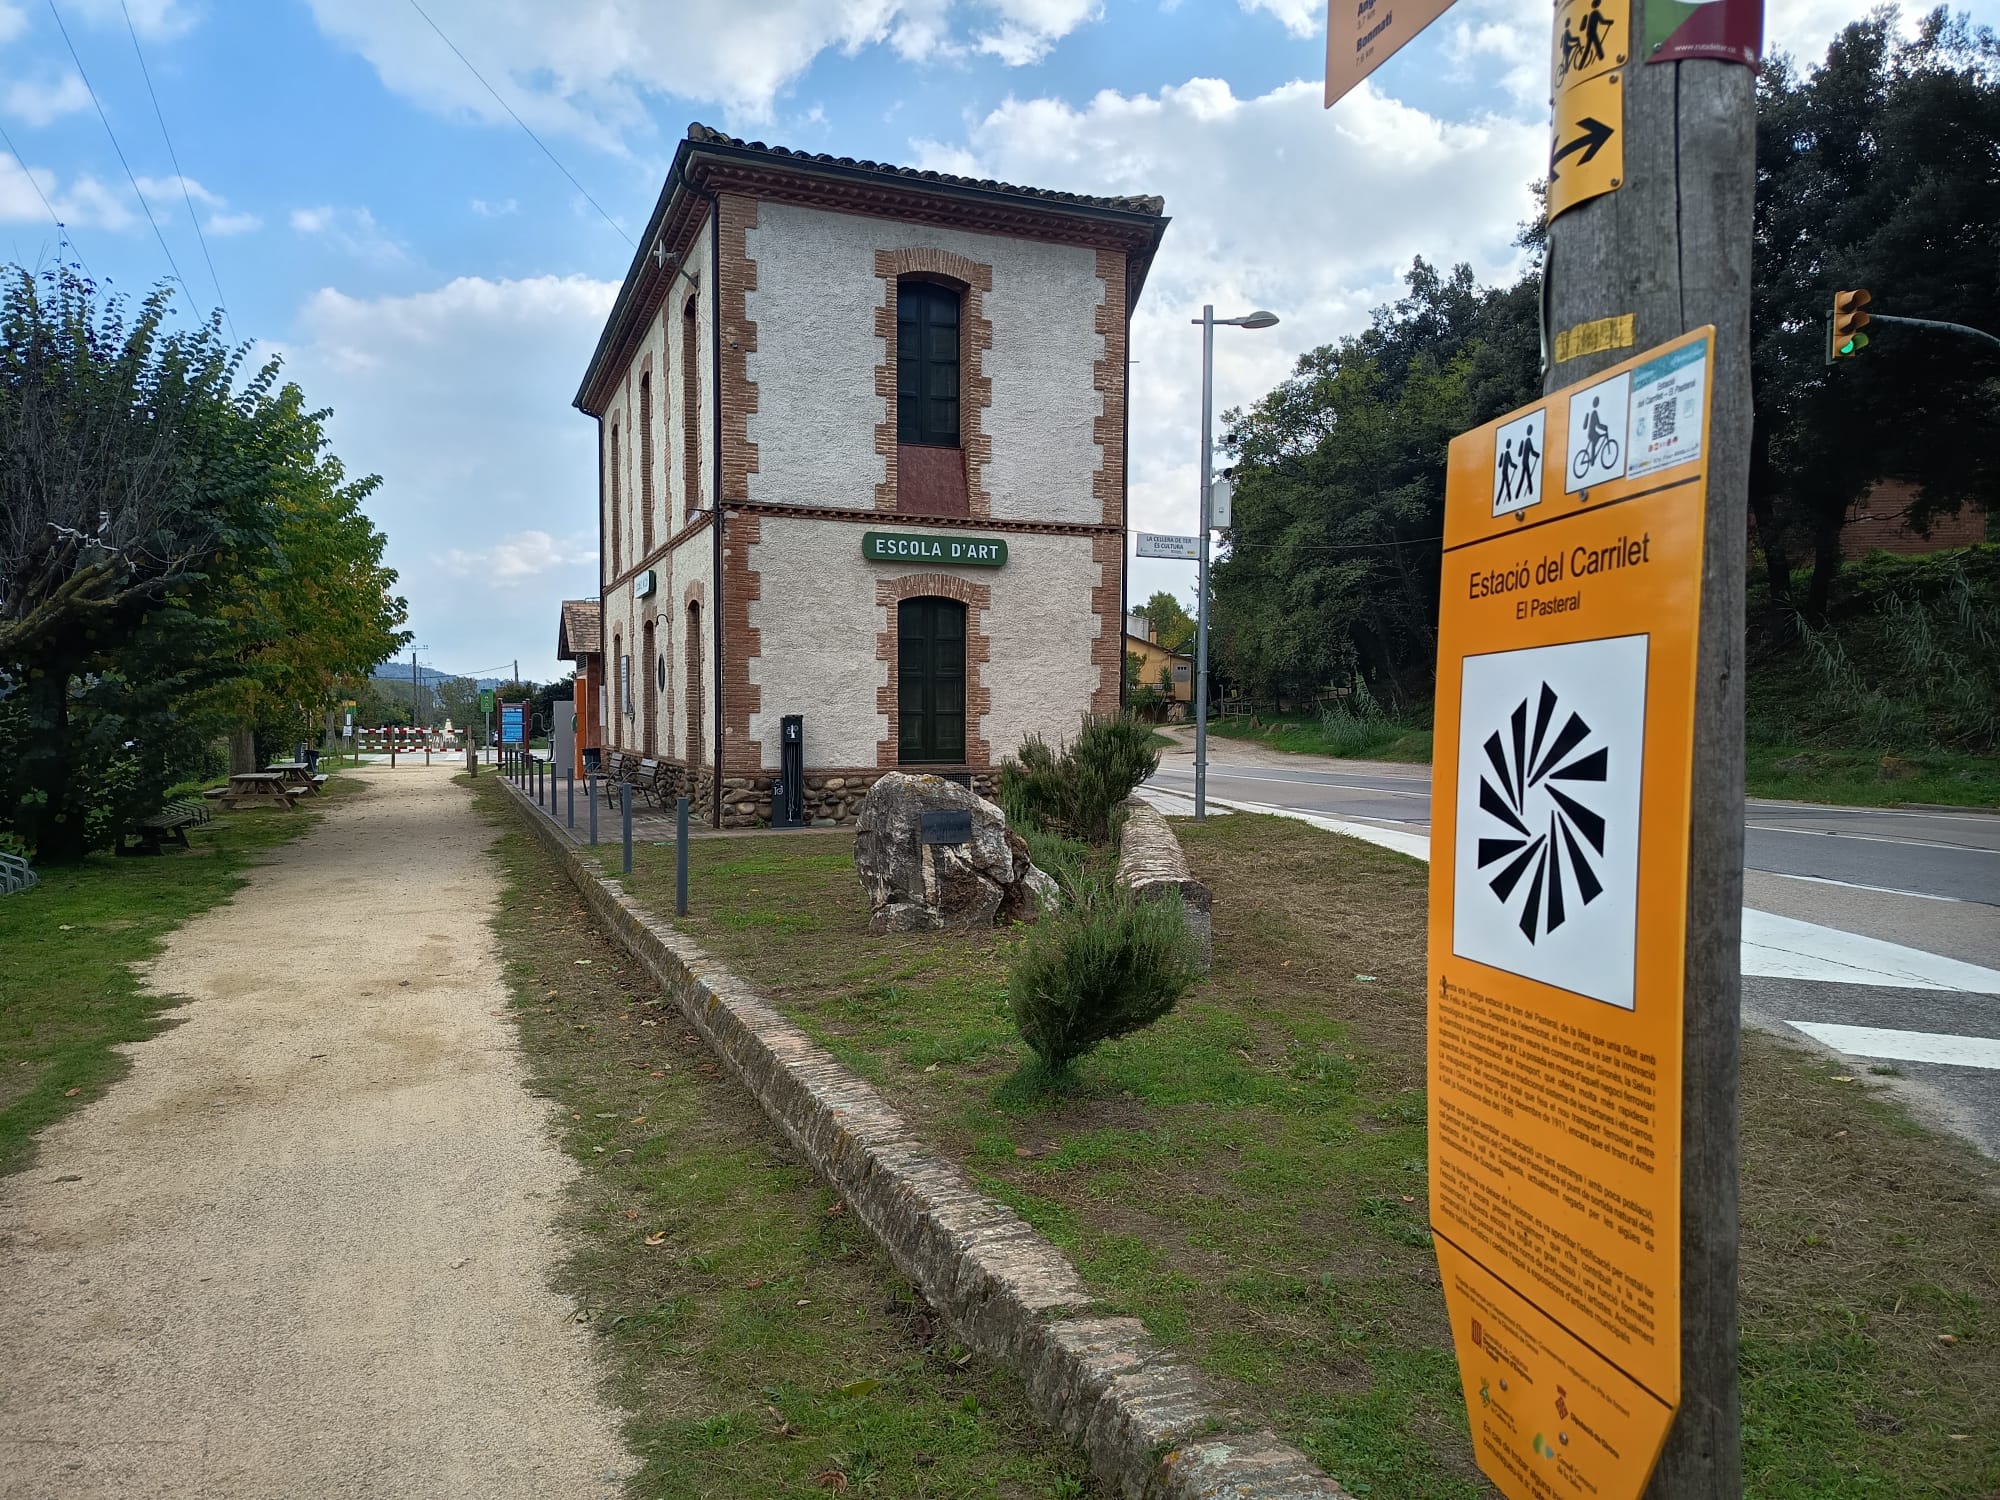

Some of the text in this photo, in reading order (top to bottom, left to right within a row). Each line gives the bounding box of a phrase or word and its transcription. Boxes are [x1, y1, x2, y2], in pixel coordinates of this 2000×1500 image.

[876, 539, 999, 559] ESCOLA D'ART
[1469, 532, 1650, 600] Estació del Carrilet
[1516, 590, 1580, 620] El Pasteral
[1640, 1053, 1656, 1066] amb
